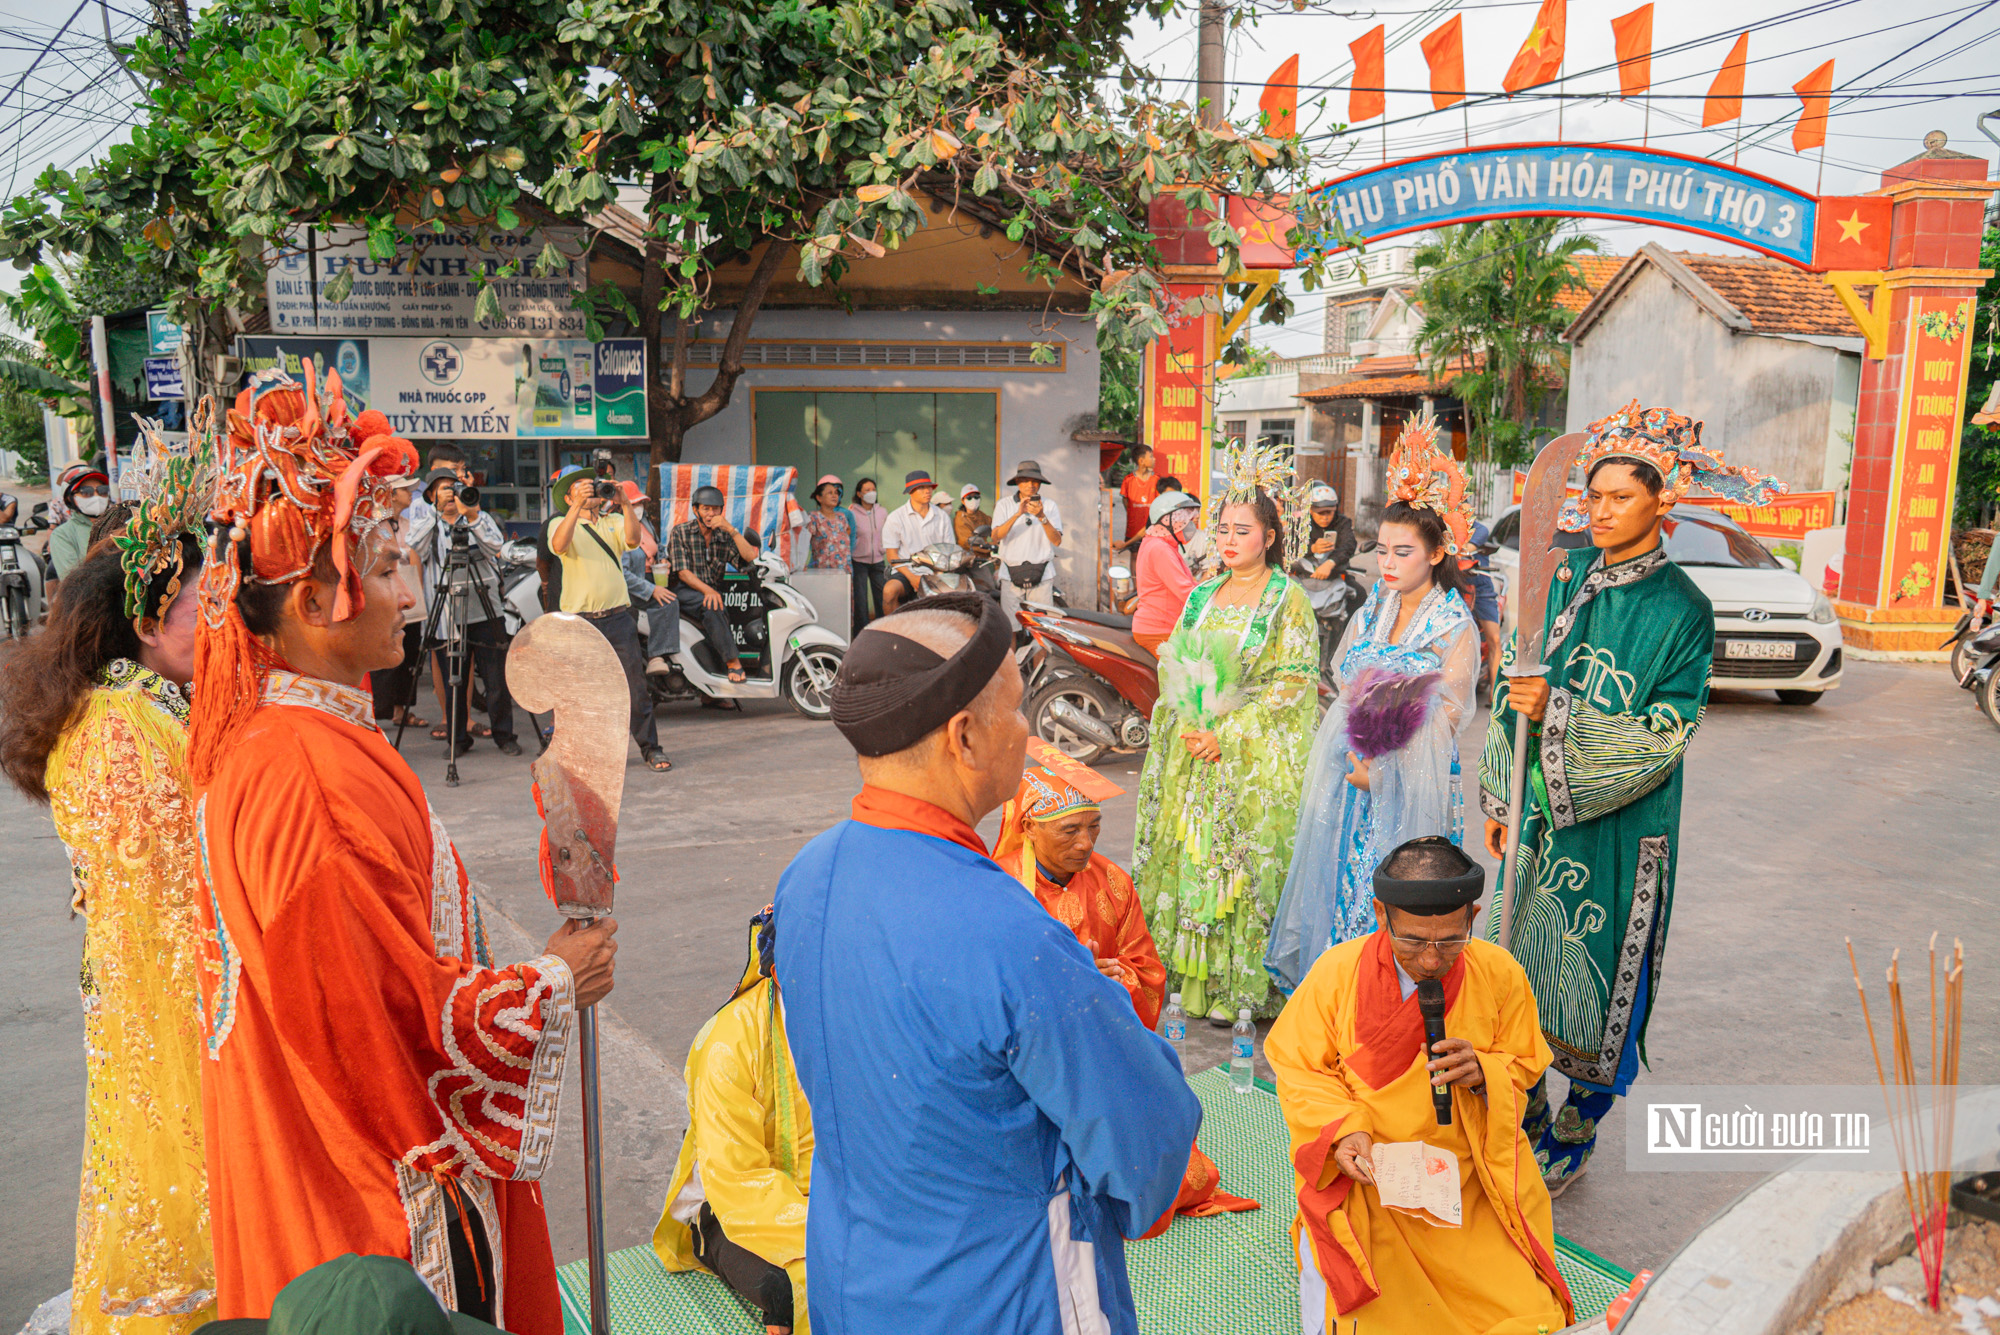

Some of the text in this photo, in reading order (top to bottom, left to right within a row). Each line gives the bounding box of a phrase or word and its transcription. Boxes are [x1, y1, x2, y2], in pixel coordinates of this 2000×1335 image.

[1392, 157, 1460, 216] PHỐ
[1470, 156, 1537, 201] VĂN
[1547, 153, 1614, 201] HÓA
[1625, 168, 1694, 211] PHÚ
[1703, 181, 1766, 236] THỌ
[1771, 204, 1796, 239] 3
[490, 235, 531, 247] GPP
[374, 280, 396, 299] ĐƯỢC
[397, 279, 418, 296] PHÉP
[333, 316, 337, 327] 3
[531, 316, 553, 330] 131
[559, 317, 584, 331] 834
[285, 354, 303, 374] GEL
[598, 344, 641, 383] Salonpas
[1924, 358, 1955, 385] VƯỢT
[399, 388, 486, 403] NHÀ THUỐC GPP
[1162, 384, 1196, 407] BÌNH
[1916, 392, 1954, 416] TRÙNG
[461, 406, 510, 433] MẾN
[1160, 421, 1197, 441] MINH
[1916, 427, 1946, 450] KHƠI
[1167, 452, 1189, 474] TÀI
[1918, 464, 1935, 484] AN
[1779, 506, 1803, 530] HỢP
